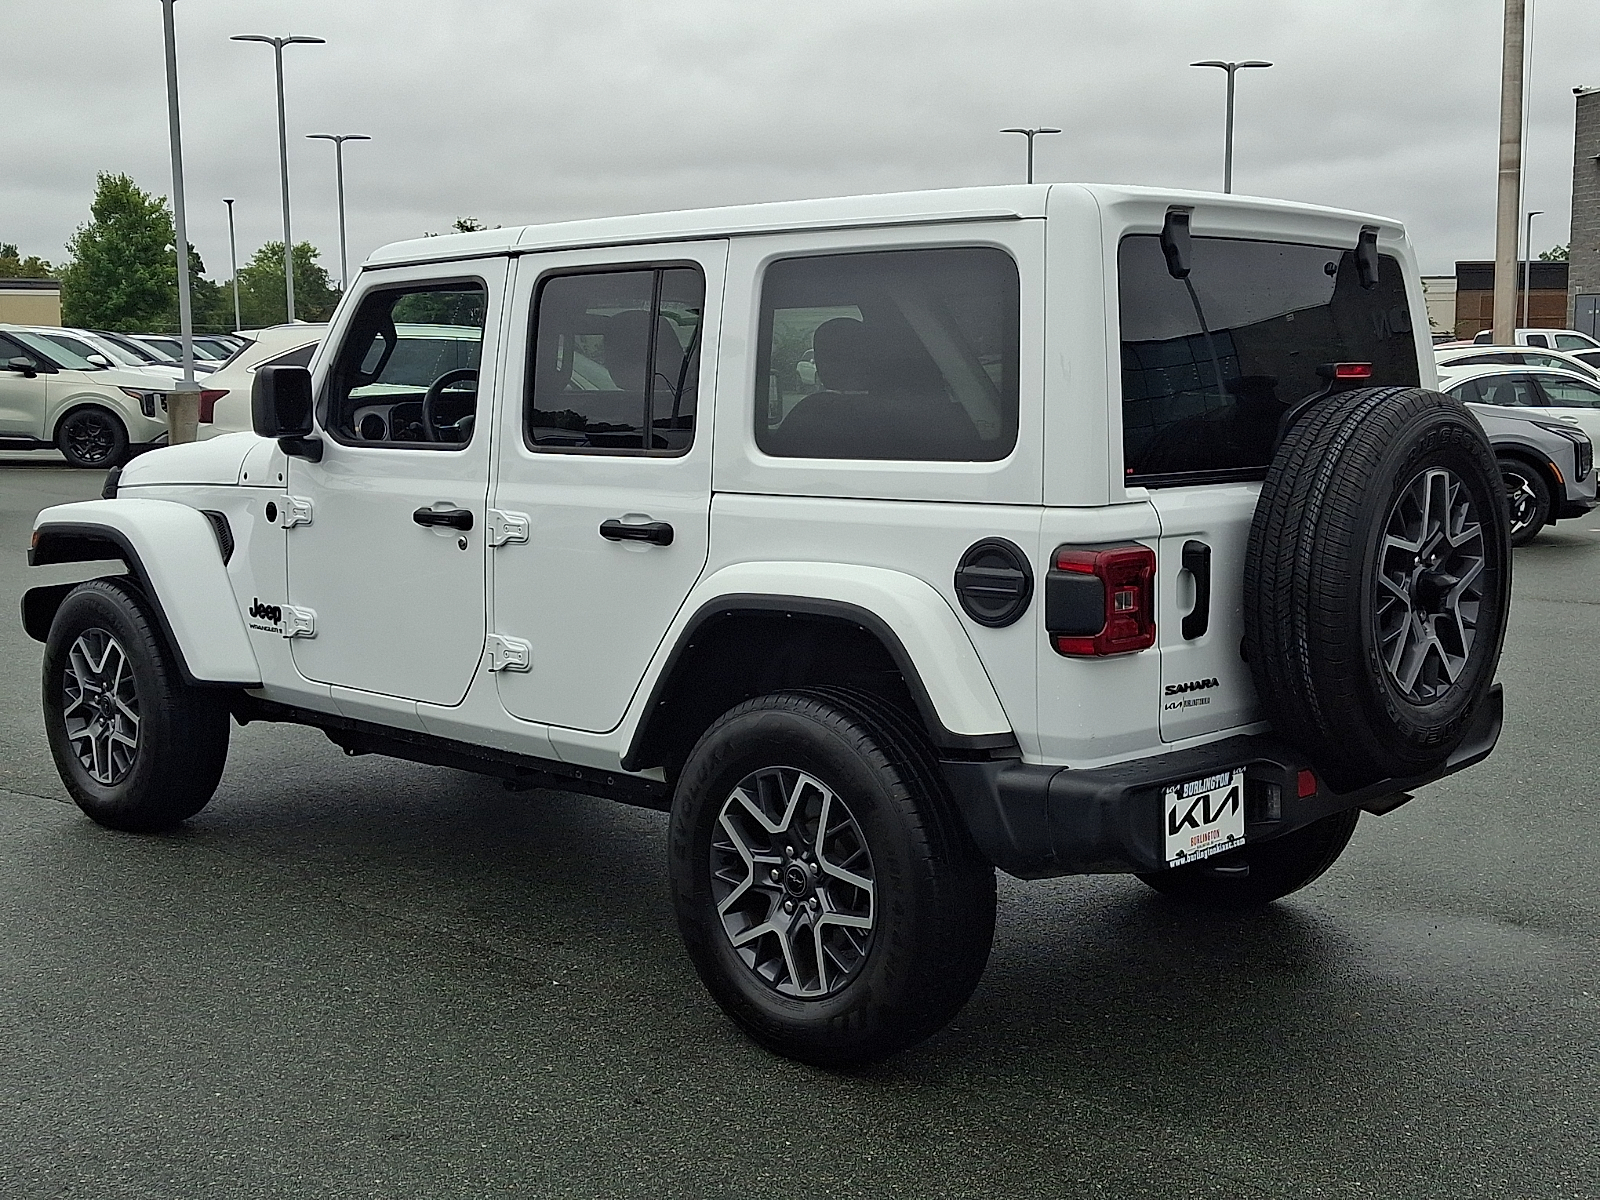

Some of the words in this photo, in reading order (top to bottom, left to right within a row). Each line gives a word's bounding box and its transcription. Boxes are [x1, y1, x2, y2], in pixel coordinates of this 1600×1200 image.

[249, 597, 282, 626] Jeep
[1165, 677, 1220, 696] SAHARA
[1183, 771, 1231, 797] BURLINGTON
[1168, 784, 1240, 837] KIA
[1190, 829, 1221, 847] BURLINGTON
